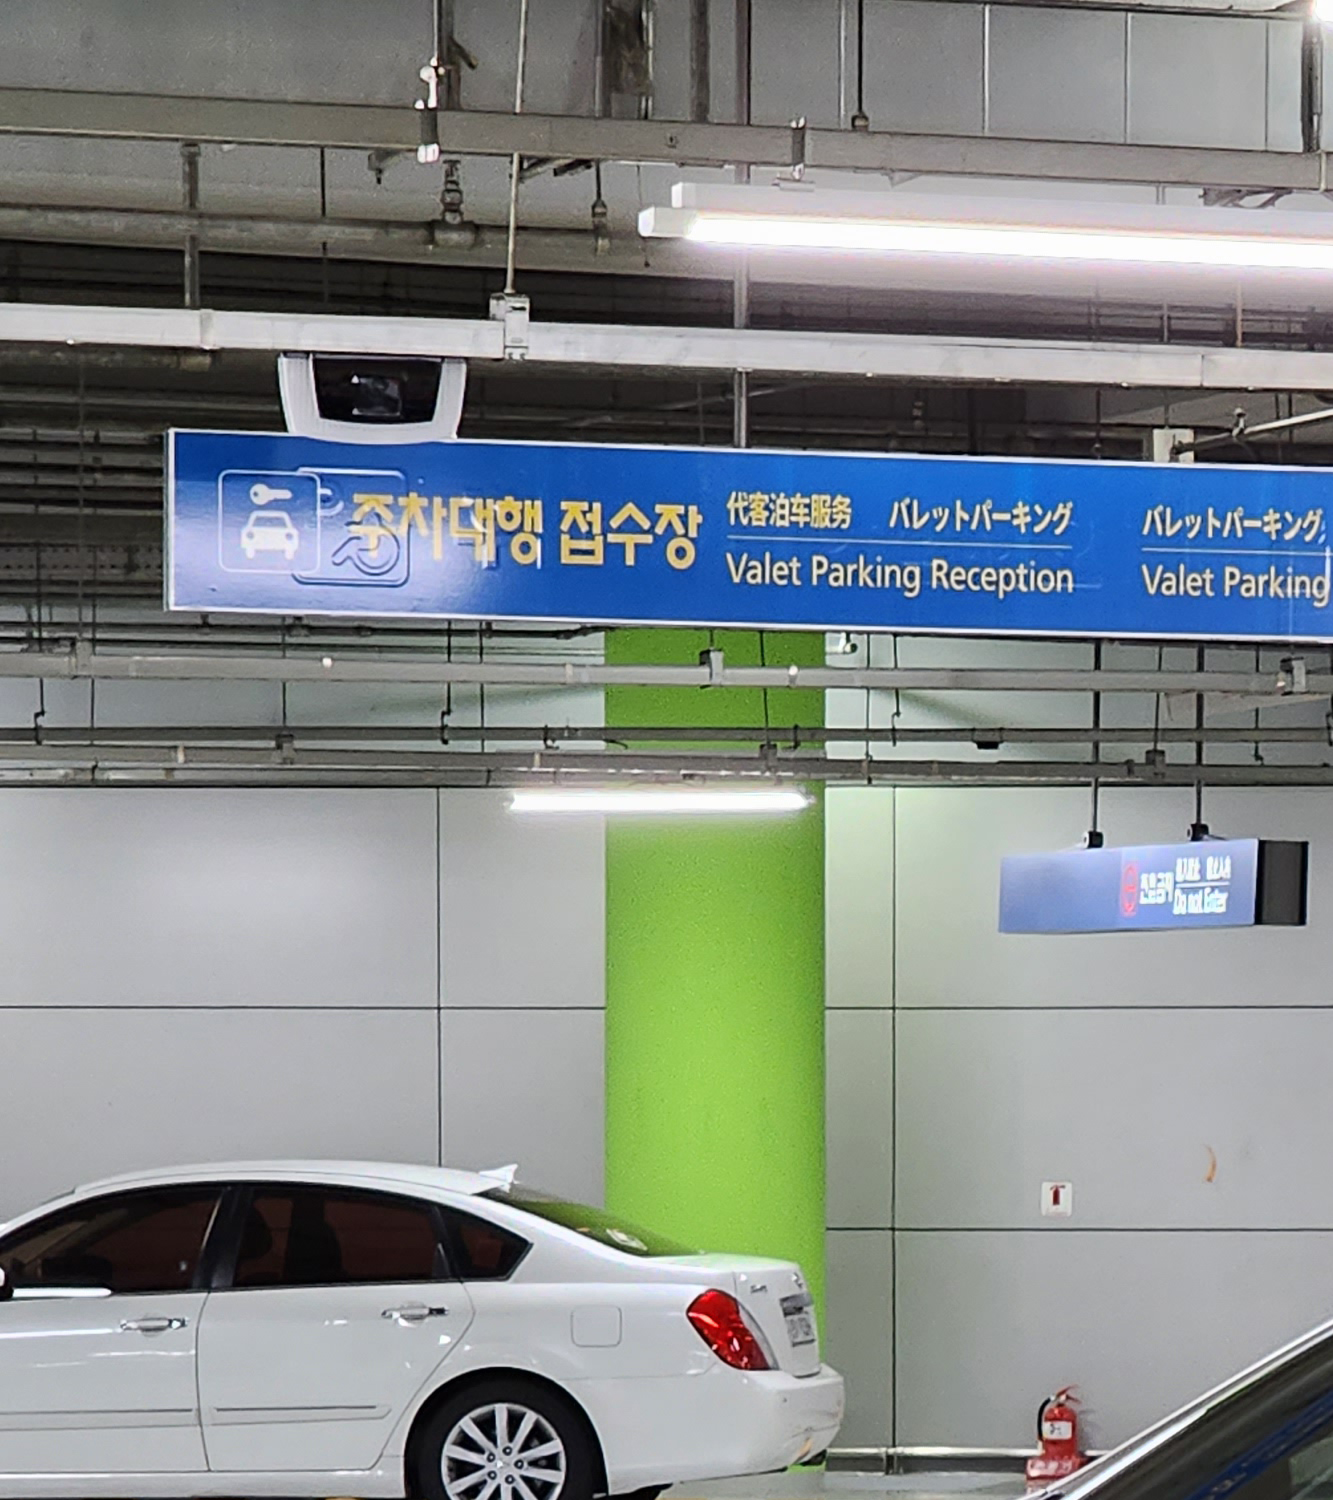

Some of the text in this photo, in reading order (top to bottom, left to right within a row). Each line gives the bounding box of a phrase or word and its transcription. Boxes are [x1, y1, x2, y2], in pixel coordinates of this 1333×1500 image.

[351, 491, 703, 570] 주차대행 접수장
[726, 491, 852, 530] 代客泊车服务
[889, 499, 1074, 536] バレットパーキング
[1142, 504, 1324, 543] バレットパーキング
[725, 551, 1074, 600] Valet Parking Reception
[1141, 563, 1215, 598] Valet
[1224, 565, 1331, 608] Parking
